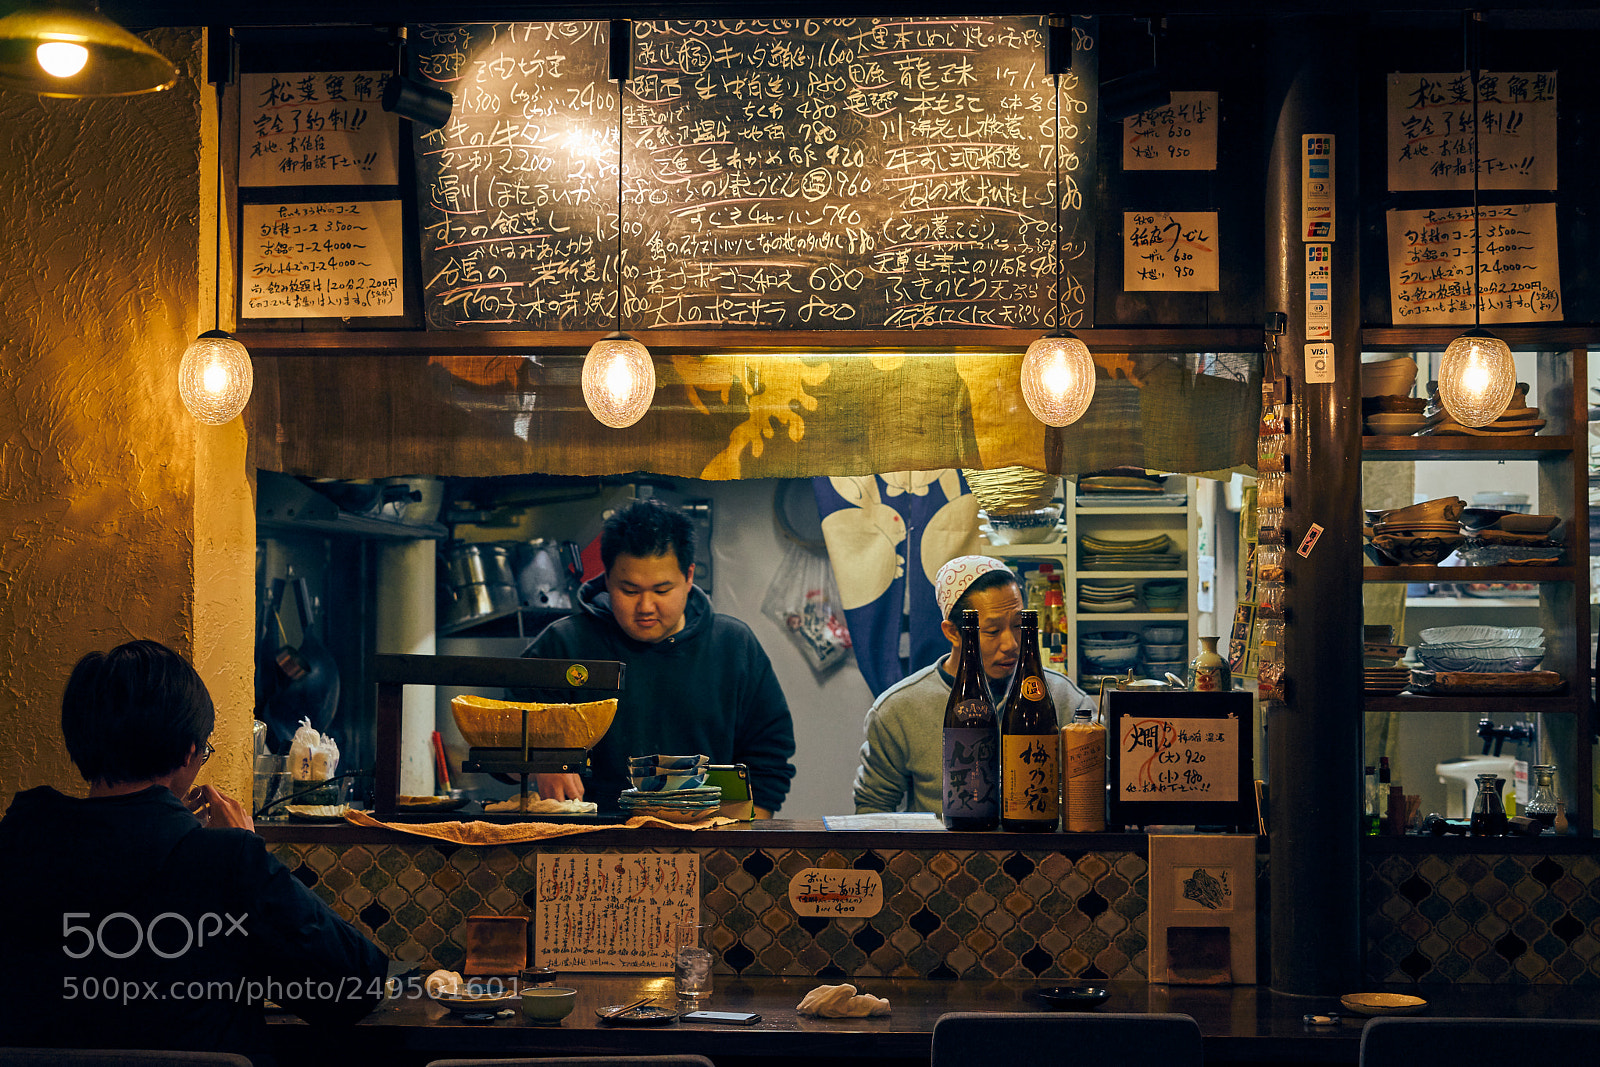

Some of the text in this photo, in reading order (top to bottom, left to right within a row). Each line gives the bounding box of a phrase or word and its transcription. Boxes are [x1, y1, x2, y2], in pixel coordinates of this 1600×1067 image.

[1168, 126, 1191, 138] 630
[1167, 145, 1190, 158] 950
[1173, 248, 1193, 262] 630
[1174, 266, 1195, 278] 950
[1185, 749, 1206, 764] 920
[1183, 769, 1203, 784] 480
[835, 903, 855, 914] 400
